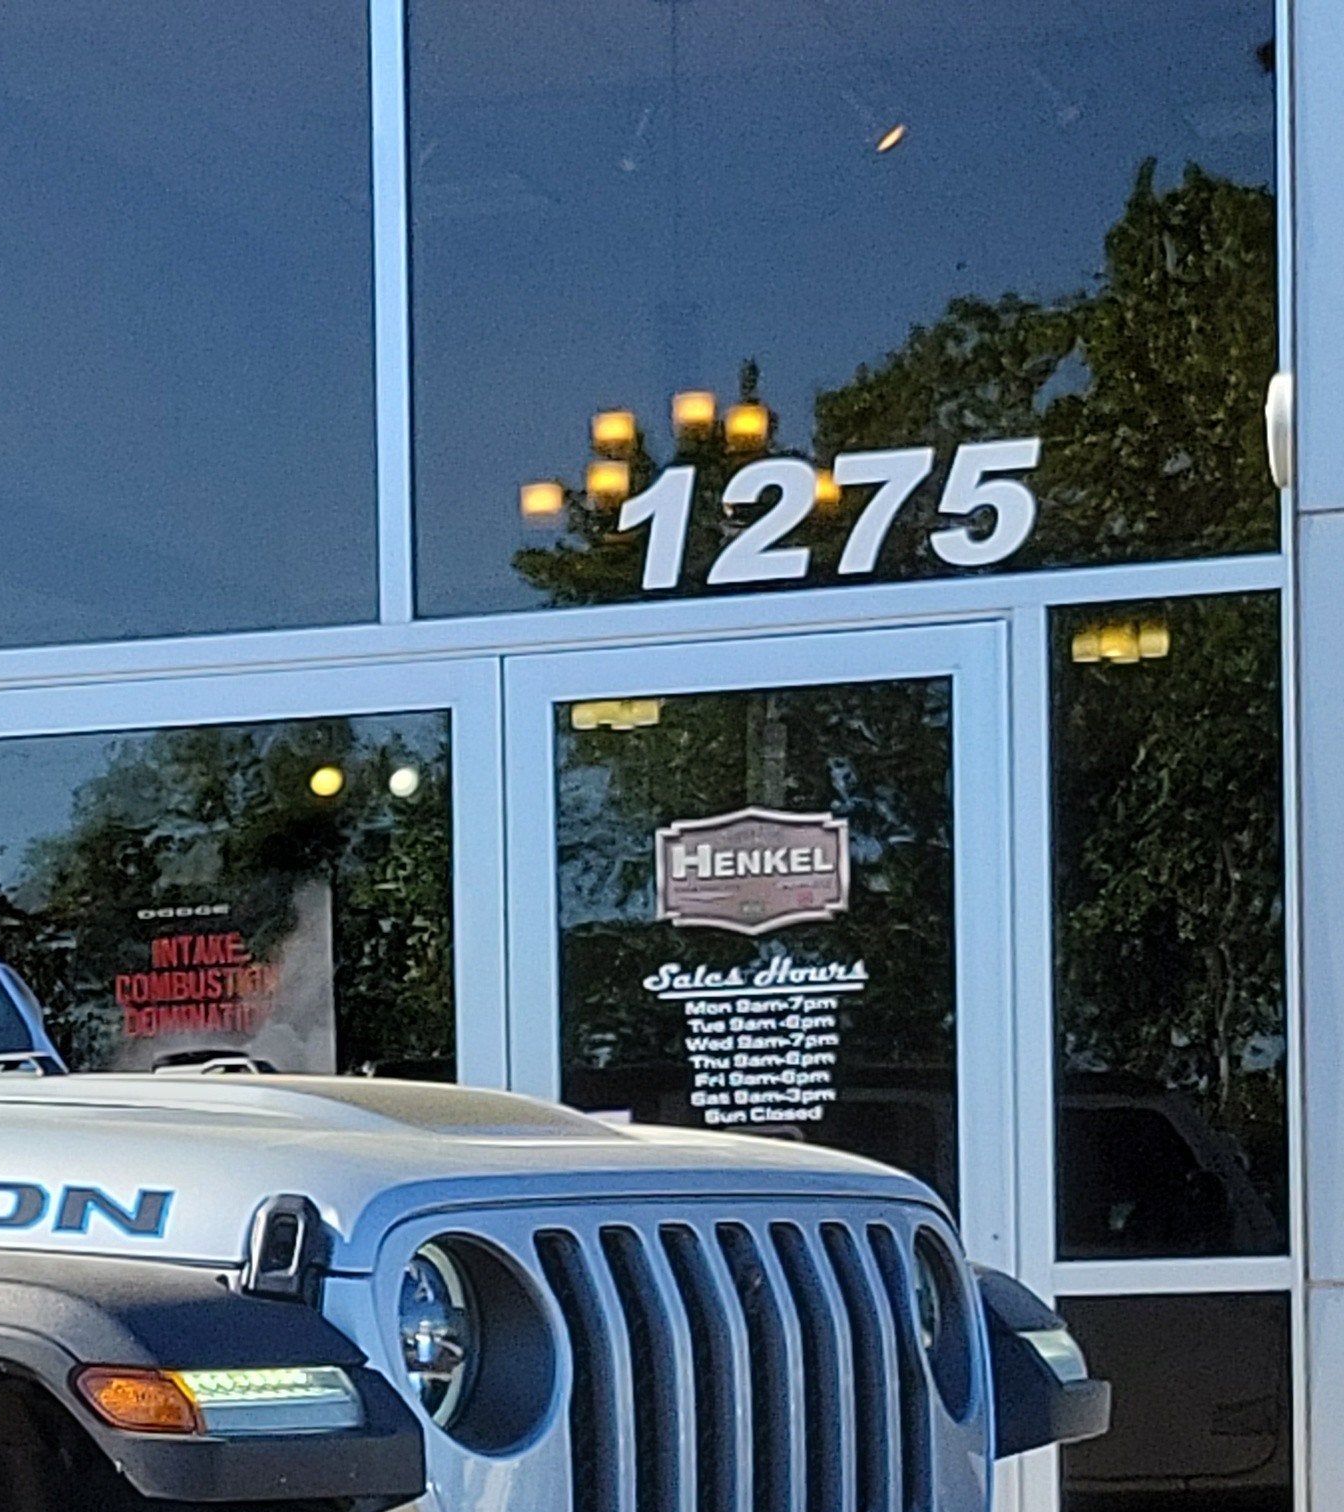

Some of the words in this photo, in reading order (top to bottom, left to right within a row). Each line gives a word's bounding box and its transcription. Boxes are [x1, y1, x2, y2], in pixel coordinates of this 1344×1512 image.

[617, 436, 1042, 591] 1275
[672, 843, 834, 880] HENKEL
[151, 931, 252, 969] INTAKE
[643, 963, 746, 992] Sales
[753, 955, 870, 987] Hours
[115, 964, 282, 1005] COMBUSTION
[685, 1000, 733, 1016] Mon
[687, 1018, 726, 1033] Tue
[685, 1035, 734, 1051] Wed
[687, 1054, 731, 1070] Thu
[694, 1072, 726, 1088] Fri
[749, 1104, 825, 1123] Closed
